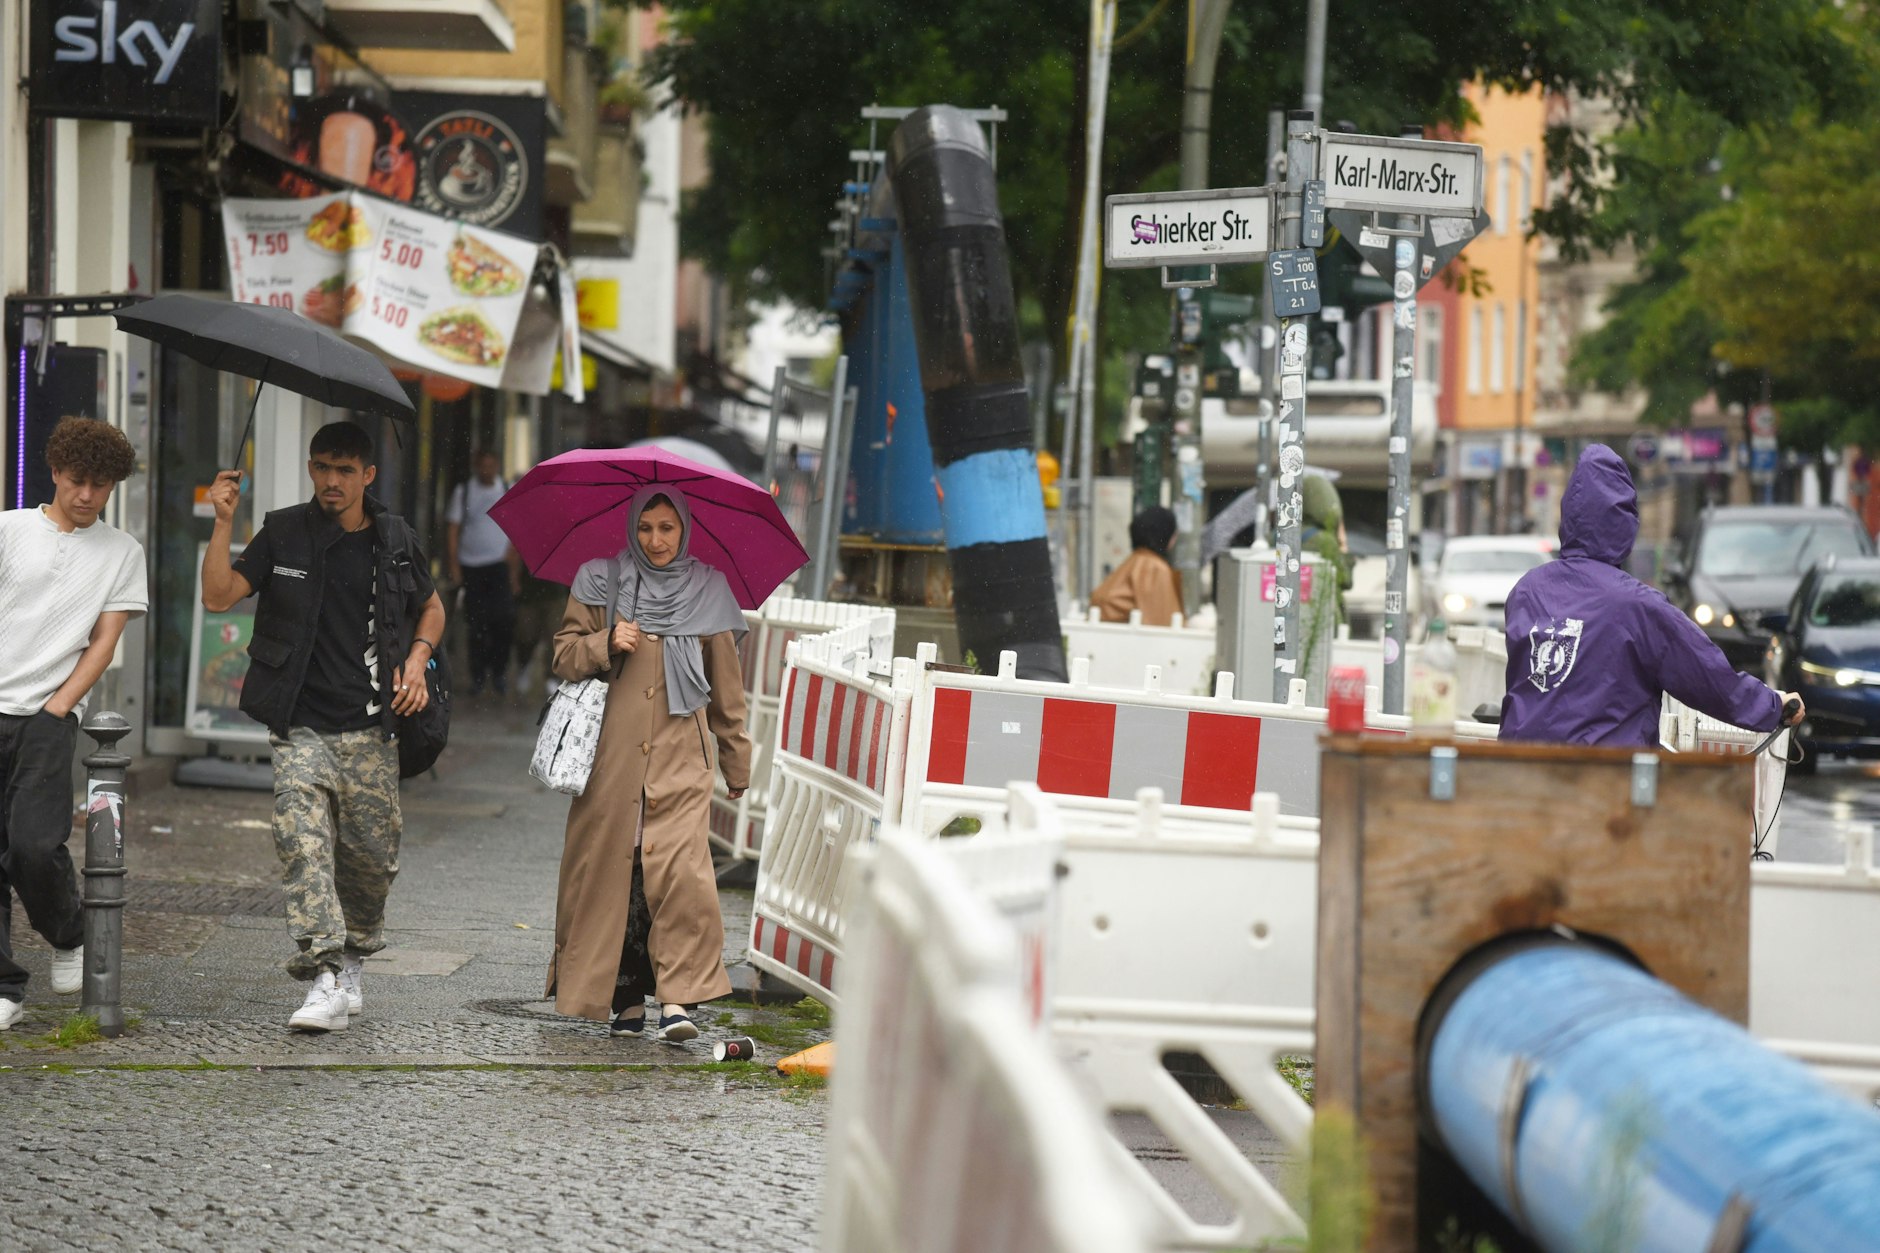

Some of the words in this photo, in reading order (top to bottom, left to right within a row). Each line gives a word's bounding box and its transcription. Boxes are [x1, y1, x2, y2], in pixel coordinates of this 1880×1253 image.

[54, 0, 196, 85] sky
[1334, 154, 1458, 196] Karl-Marx-Str.
[247, 231, 288, 256] 7.50
[1130, 212, 1217, 245] Shierker
[1222, 209, 1252, 241] Str.
[380, 237, 423, 270] 5.00
[1272, 261, 1284, 276] S
[1297, 262, 1314, 273] 100
[1301, 280, 1317, 291] 0.4
[371, 296, 409, 329] 5.00
[1291, 297, 1305, 308] 2.1
